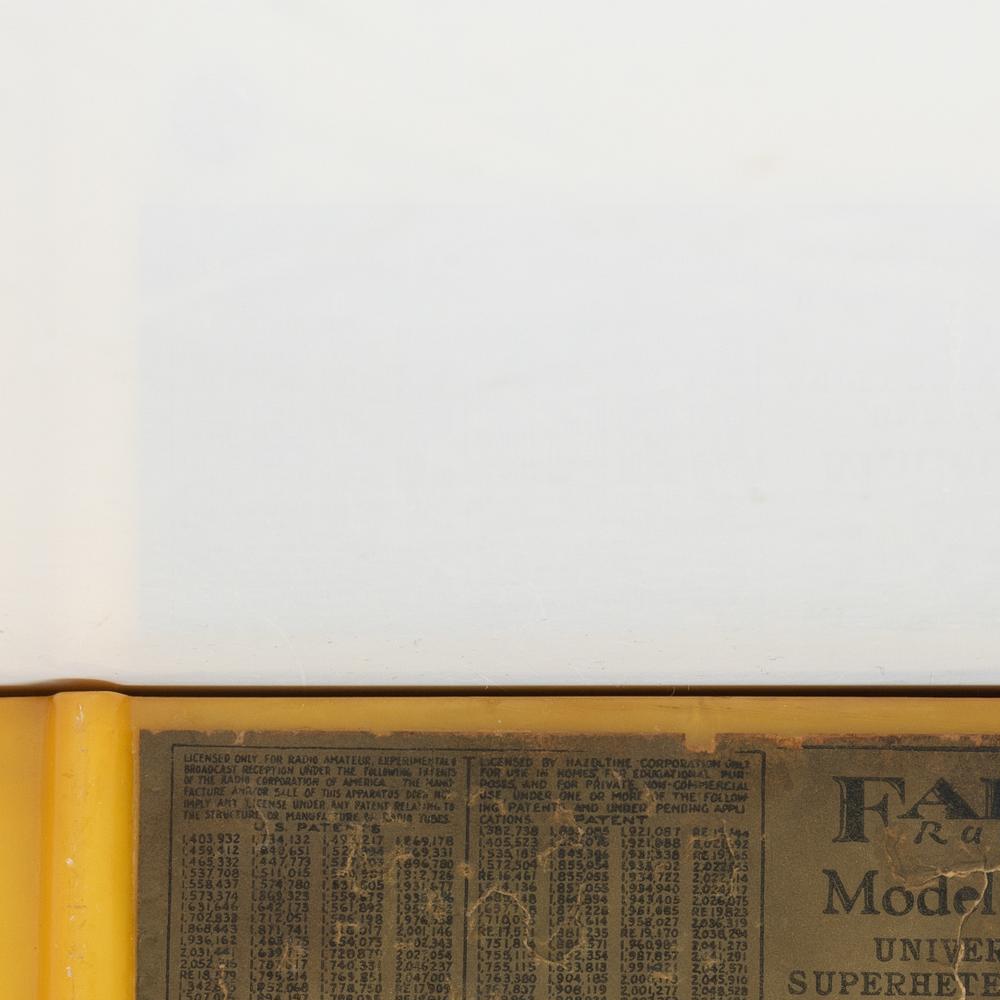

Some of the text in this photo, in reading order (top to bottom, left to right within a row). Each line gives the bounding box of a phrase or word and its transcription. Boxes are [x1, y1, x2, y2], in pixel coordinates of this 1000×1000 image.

[184, 753, 230, 764] LICENSED
[234, 754, 257, 765] ONLY
[264, 755, 283, 765] FOR
[288, 755, 319, 765] RADIO
[672, 792, 697, 801] THE
[480, 802, 500, 811] ING
[656, 802, 710, 813] PENDING
[285, 811, 359, 821] MANUFATURE
[297, 822, 382, 833] PATENS
[822, 869, 997, 917] Model
